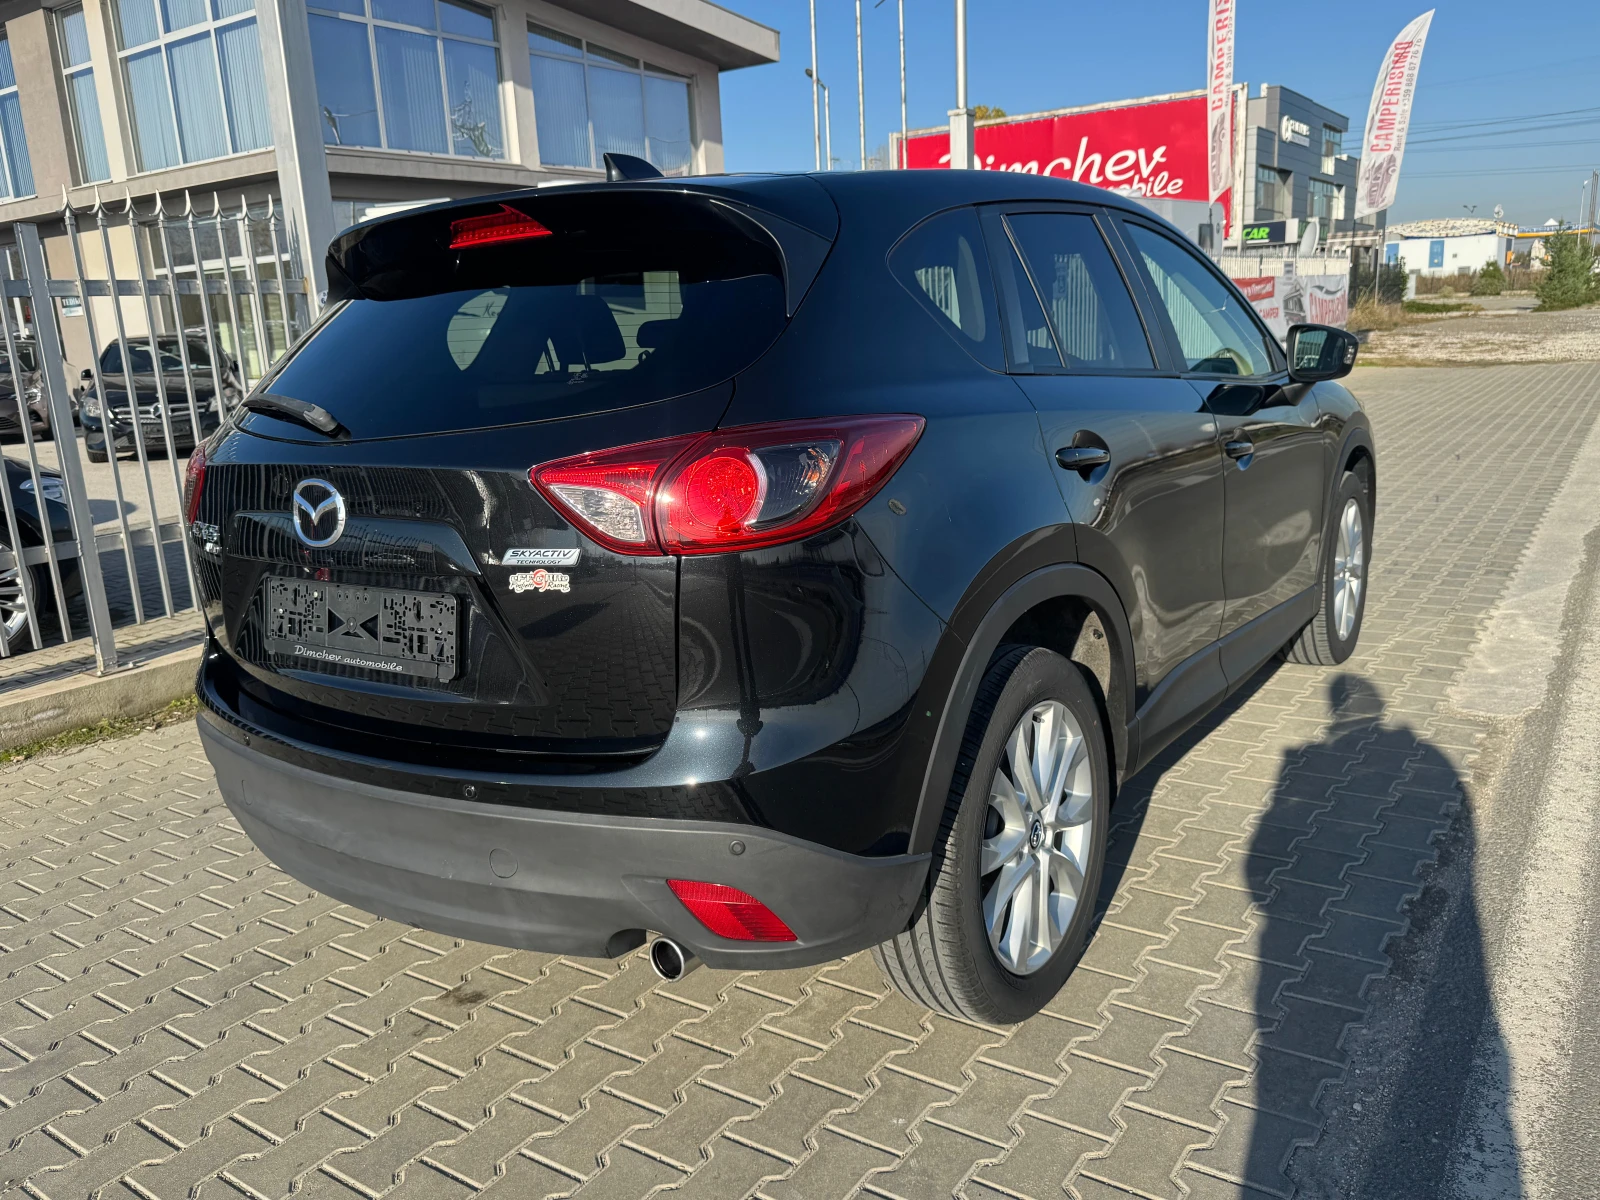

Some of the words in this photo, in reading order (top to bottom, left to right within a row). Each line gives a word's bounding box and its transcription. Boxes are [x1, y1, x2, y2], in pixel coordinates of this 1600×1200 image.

[1370, 41, 1414, 153] CAMPERISIMO
[939, 137, 1167, 184] chev
[1243, 227, 1270, 239] CAR
[510, 550, 572, 558] SKYACTIV
[294, 645, 342, 660] Dimchev
[344, 656, 403, 671] automobile
